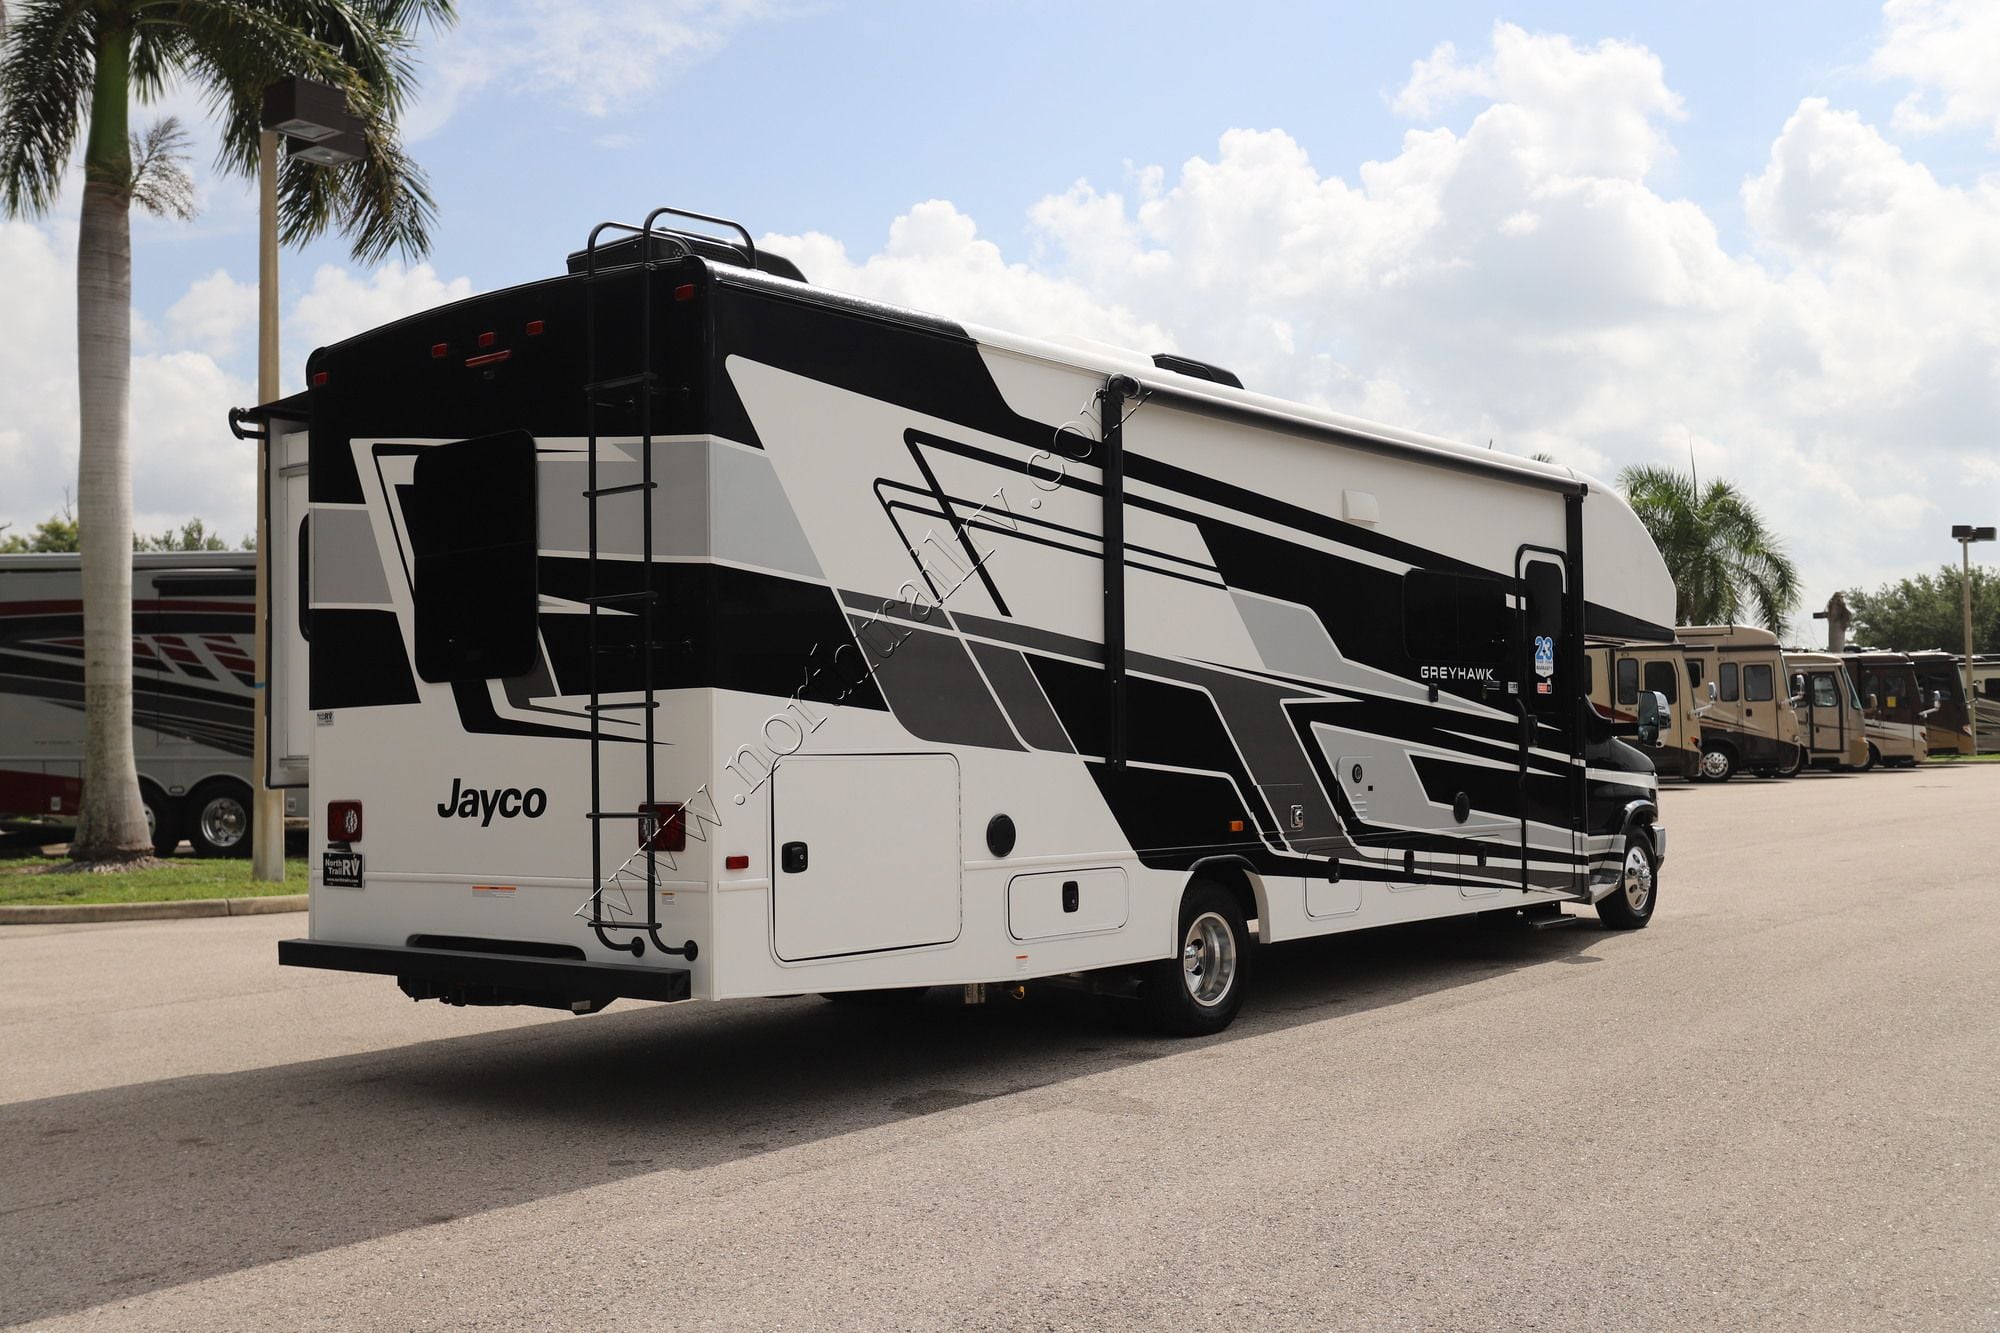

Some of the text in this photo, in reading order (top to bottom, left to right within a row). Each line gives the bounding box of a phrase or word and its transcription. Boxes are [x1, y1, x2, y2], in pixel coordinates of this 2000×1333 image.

[1420, 665, 1494, 680] GREYHAWK
[437, 778, 547, 827] Jayco
[325, 858, 343, 868] North
[328, 866, 343, 875] Trail
[342, 858, 361, 876] RV
